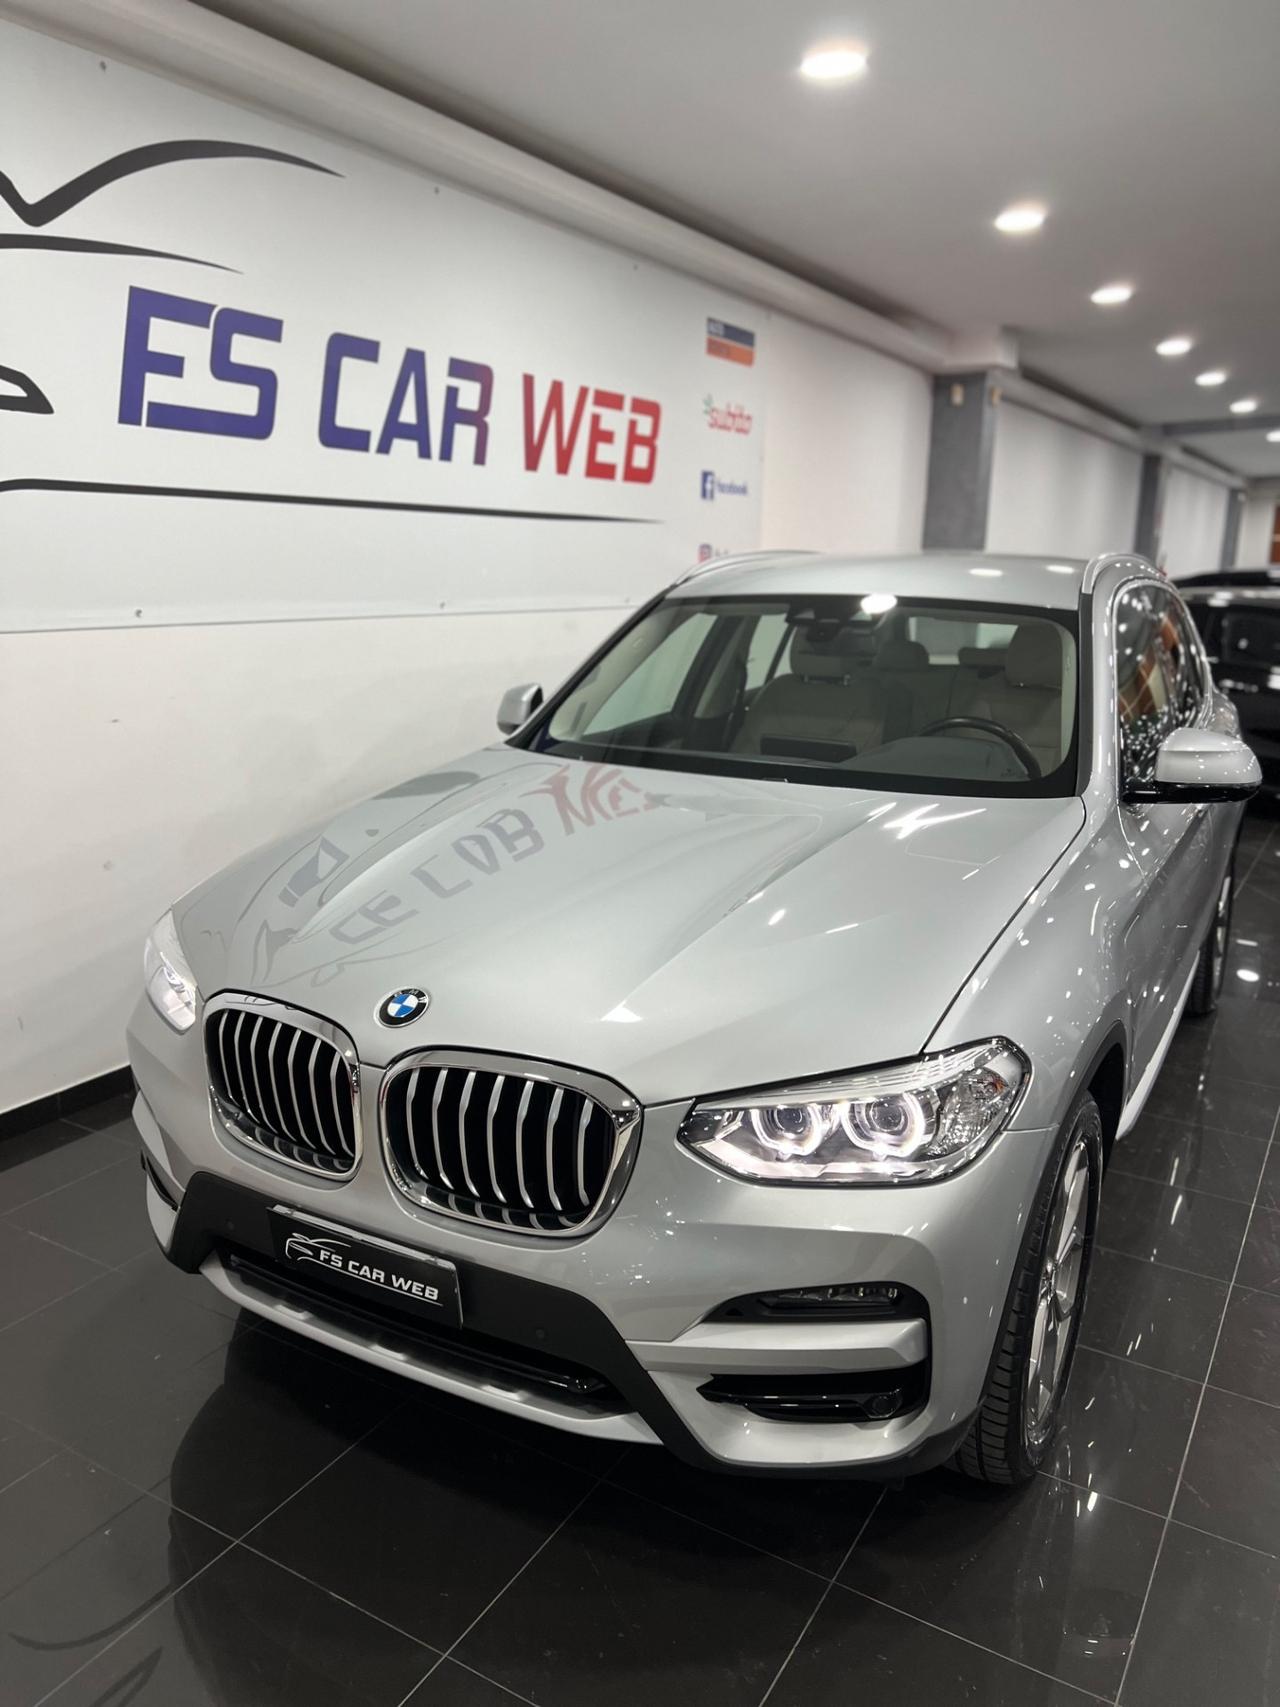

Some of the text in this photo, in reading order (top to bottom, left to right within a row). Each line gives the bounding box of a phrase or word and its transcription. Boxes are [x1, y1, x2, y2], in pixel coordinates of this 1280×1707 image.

[319, 331, 495, 467] CAR
[521, 371, 664, 487] WEB
[320, 1249, 439, 1301] FS CAR WEB
